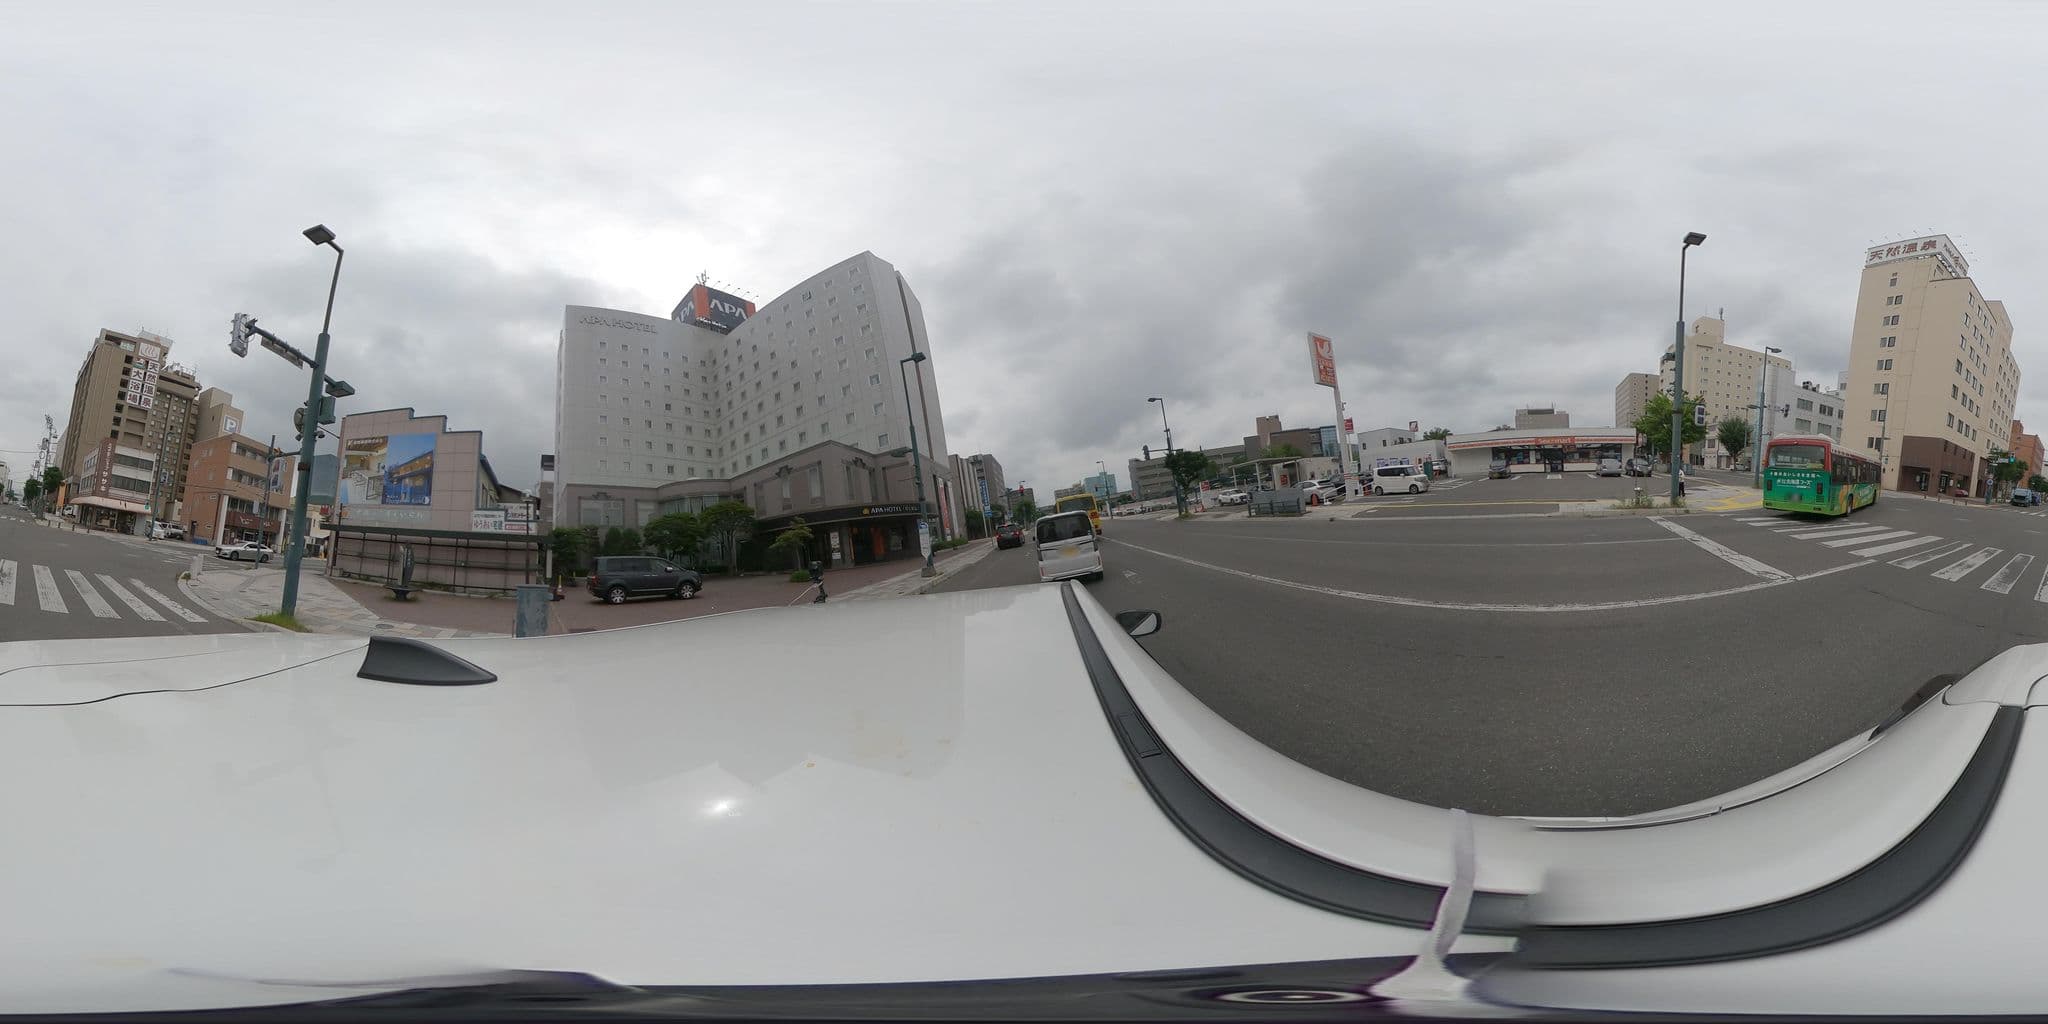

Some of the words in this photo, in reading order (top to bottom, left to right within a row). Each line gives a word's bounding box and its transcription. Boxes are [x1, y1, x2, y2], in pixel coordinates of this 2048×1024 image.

[1868, 240, 1938, 261] 天然温泉
[710, 298, 748, 320] APA
[579, 315, 610, 327] APA
[612, 319, 657, 334] HOTEL
[127, 369, 143, 405] 大浴場
[142, 361, 159, 408] 天然温泉
